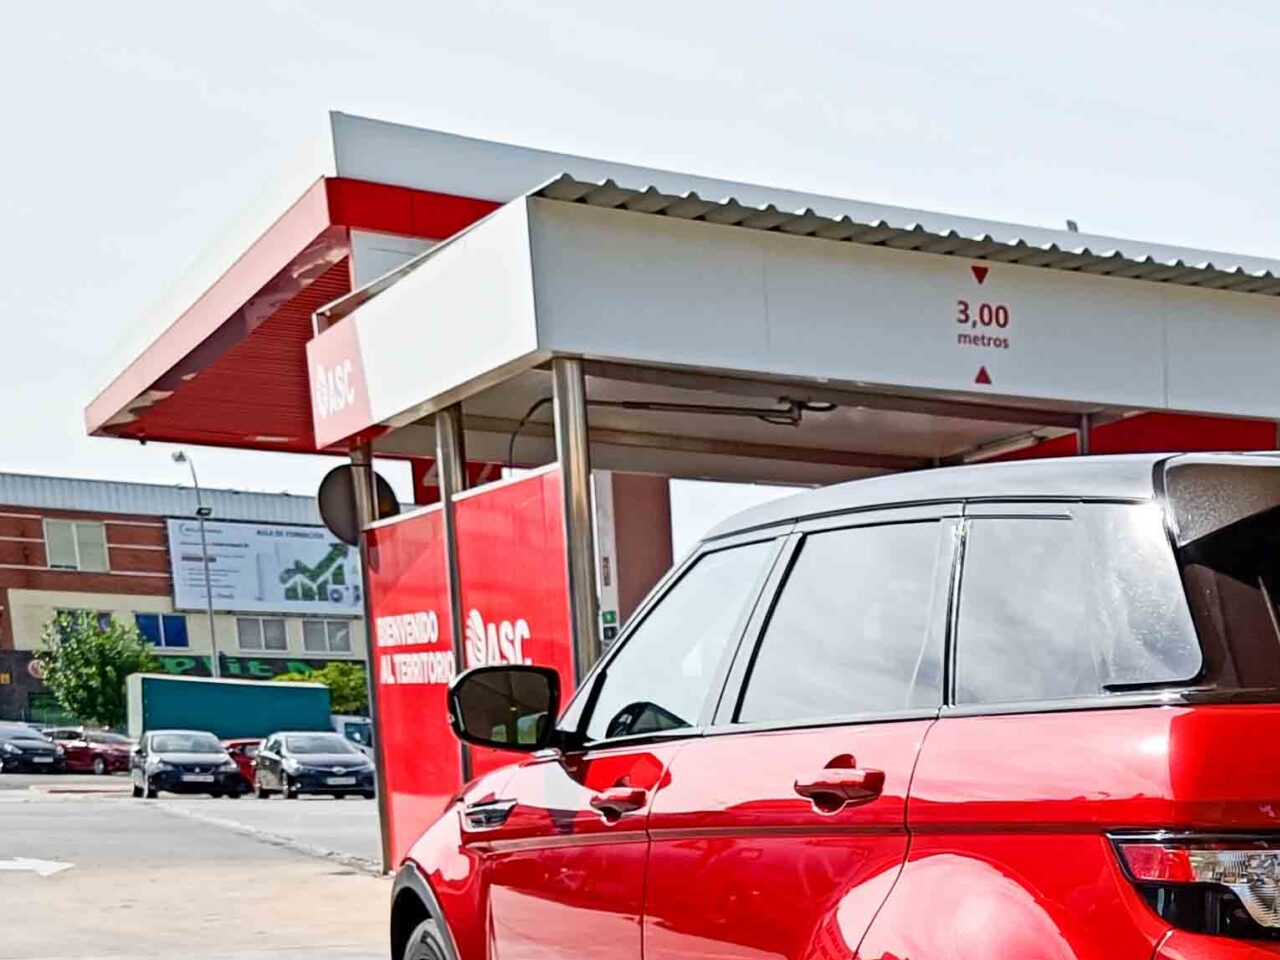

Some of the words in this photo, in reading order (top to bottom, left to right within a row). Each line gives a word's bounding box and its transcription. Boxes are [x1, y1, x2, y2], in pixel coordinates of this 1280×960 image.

[957, 300, 1010, 329] 3,00
[957, 332, 1010, 349] metros
[327, 359, 356, 417] ASC
[376, 610, 439, 648] BIENVENIDO
[379, 654, 396, 685] AL
[393, 650, 457, 685] TERRITORIO
